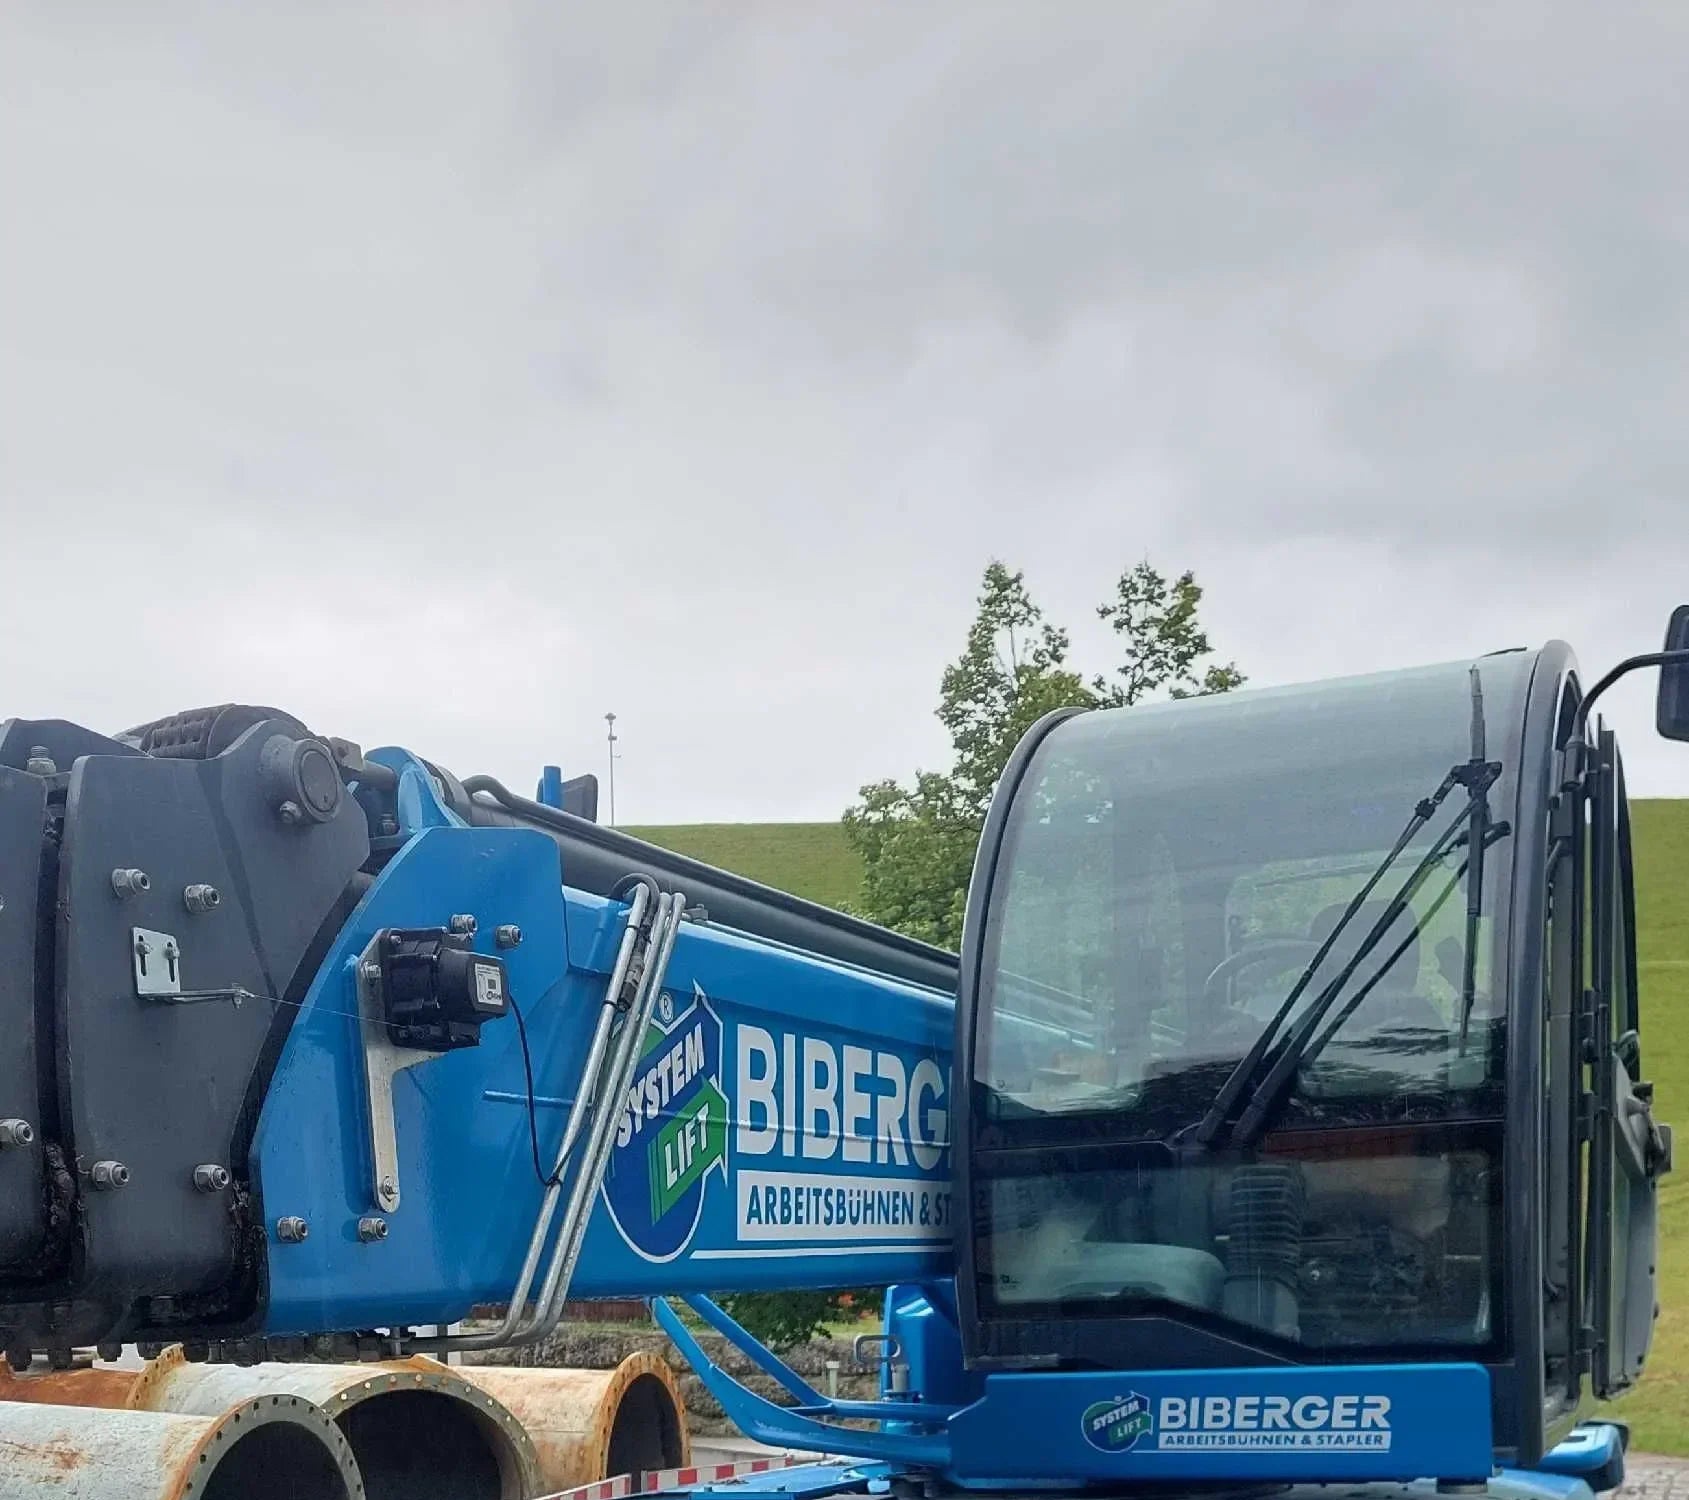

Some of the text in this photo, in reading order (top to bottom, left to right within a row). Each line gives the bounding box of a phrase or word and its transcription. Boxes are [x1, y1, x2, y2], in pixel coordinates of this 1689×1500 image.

[617, 1022, 705, 1148] SYSTEM
[737, 1023, 952, 1170] BIBERG
[664, 1102, 709, 1190] LIFT
[746, 1184, 914, 1225] ARBEITSBÜHNEN
[919, 1191, 931, 1226] &
[1093, 1400, 1140, 1431] SYSTEM
[1117, 1417, 1143, 1437] LIFT
[1158, 1396, 1391, 1429] BIBERGER
[1300, 1434, 1312, 1446] &
[1315, 1433, 1384, 1446] STAPLER
